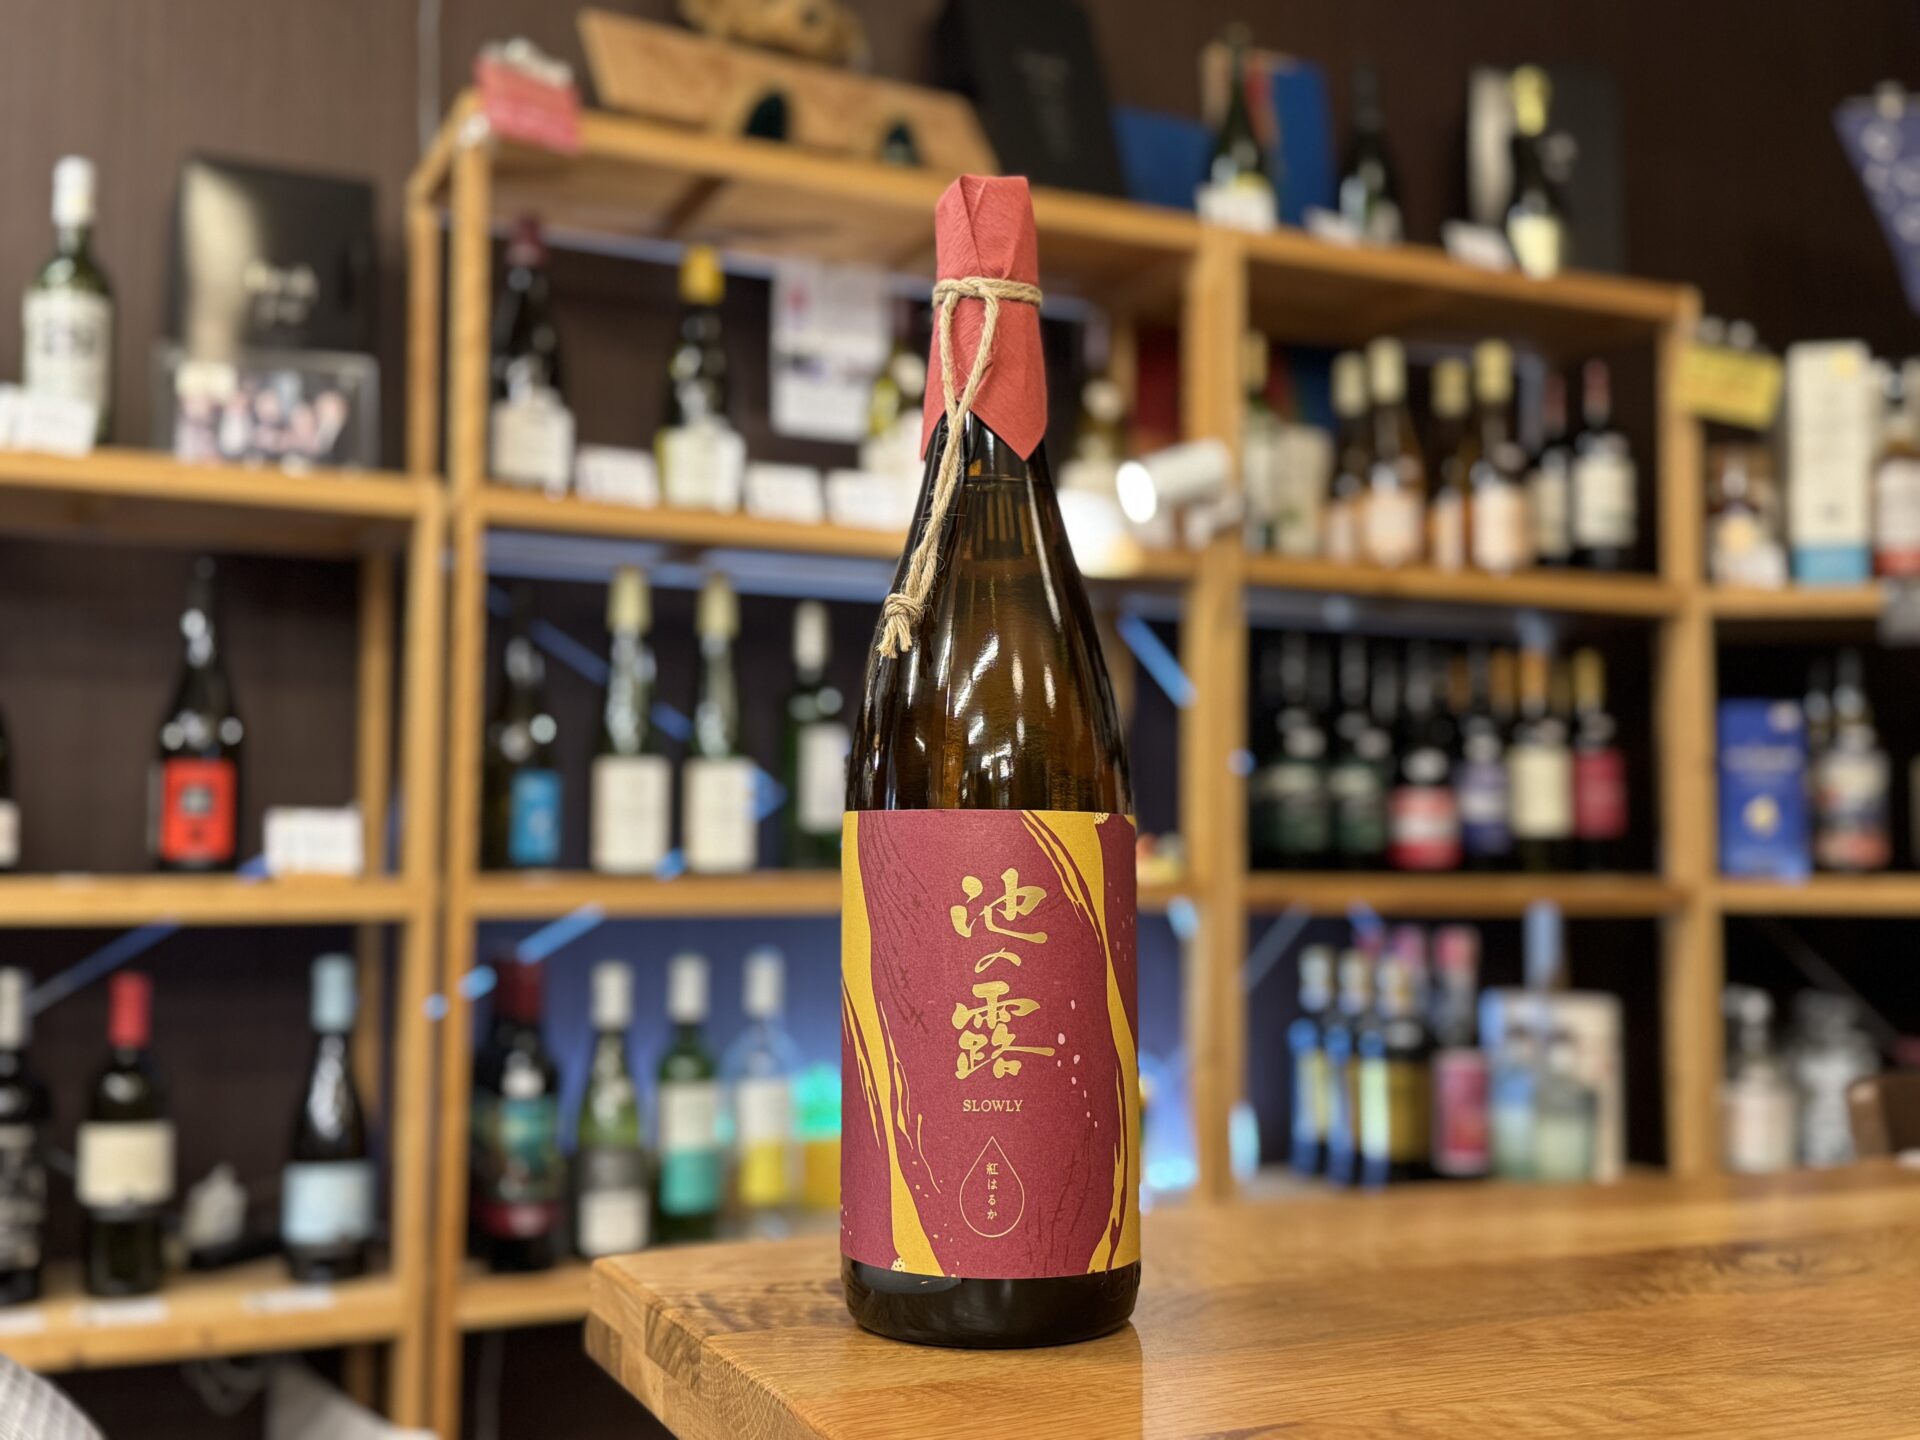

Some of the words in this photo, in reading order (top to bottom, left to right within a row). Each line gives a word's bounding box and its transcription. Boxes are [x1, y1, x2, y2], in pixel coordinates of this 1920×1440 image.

[950, 868, 1055, 1080] 池の露
[962, 1099, 1023, 1113] SLOWLY
[986, 1162, 999, 1220] 紅はるか
